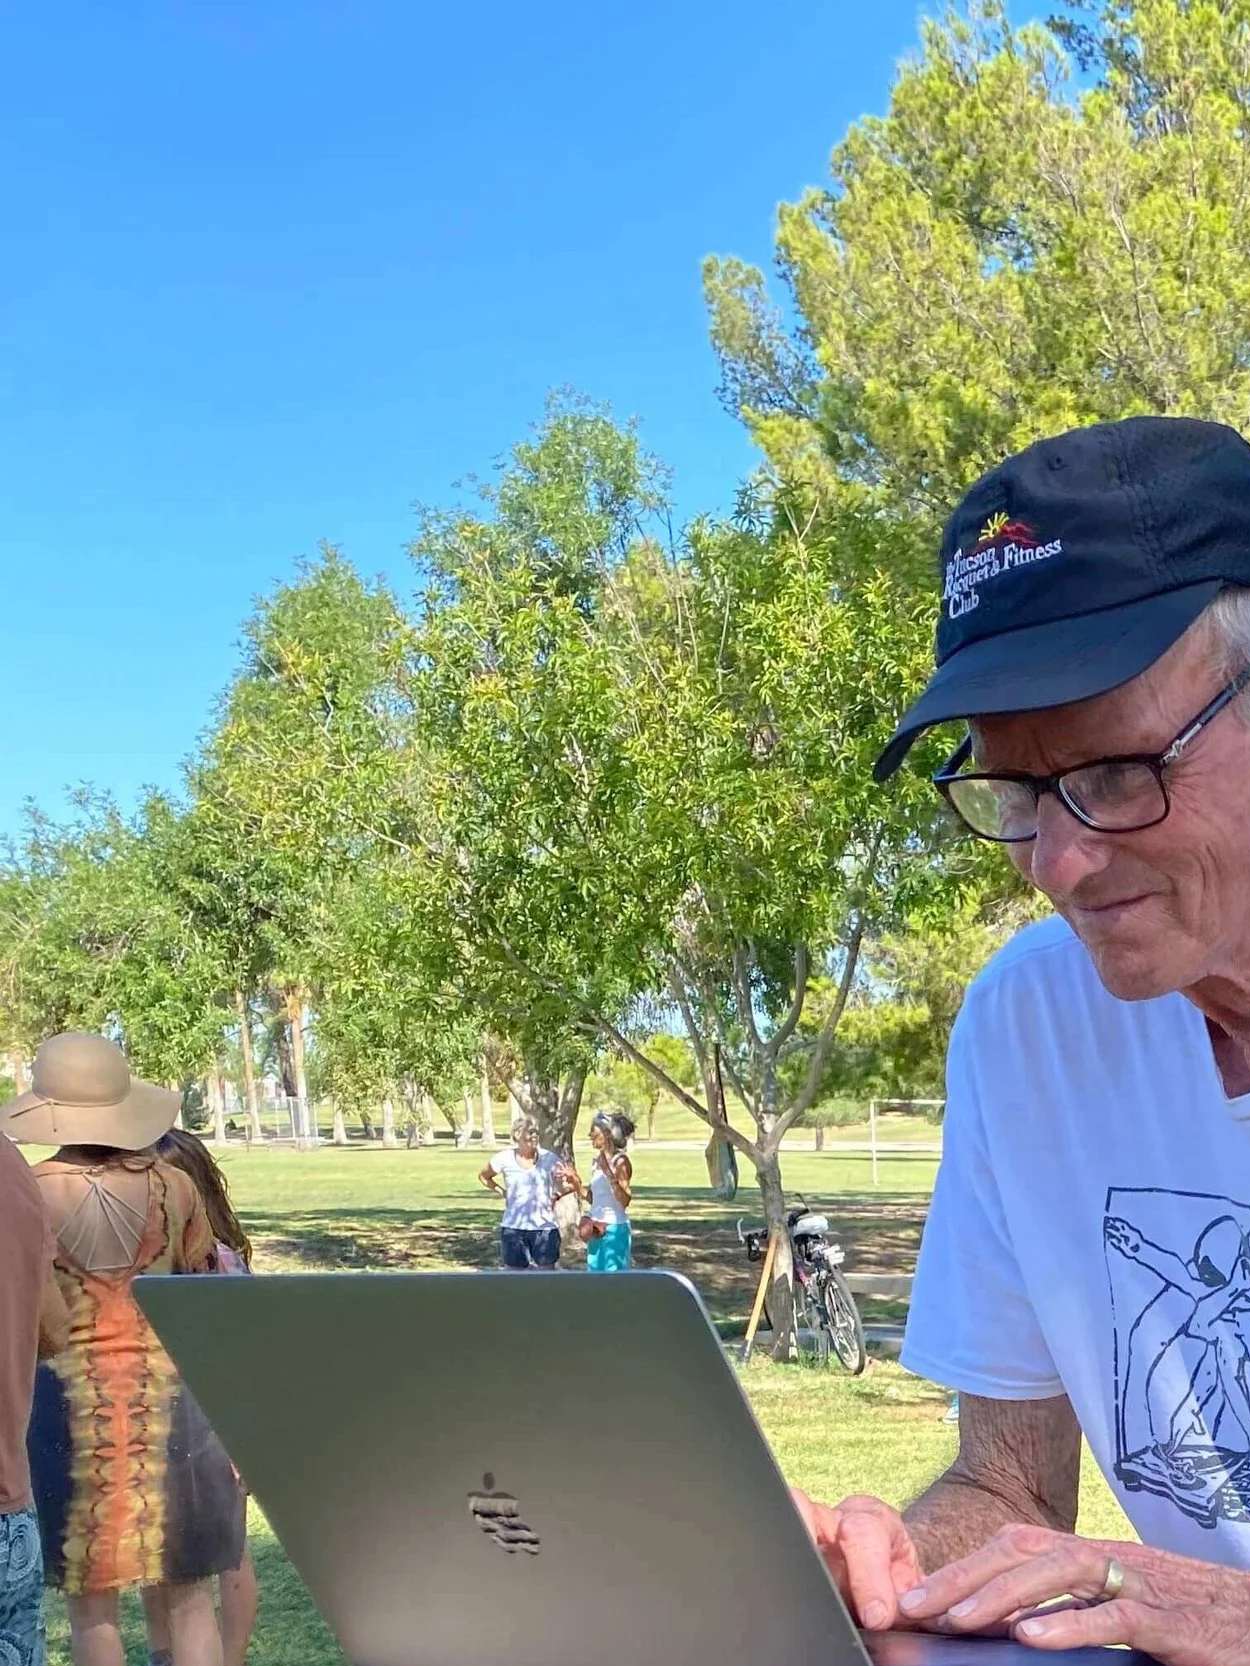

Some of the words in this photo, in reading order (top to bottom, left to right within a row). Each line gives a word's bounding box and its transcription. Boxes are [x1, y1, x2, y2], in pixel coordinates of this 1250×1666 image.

[953, 547, 996, 577] Tucson
[990, 560, 1001, 577] &
[1001, 538, 1062, 571] Fitness
[948, 587, 979, 619] Club
